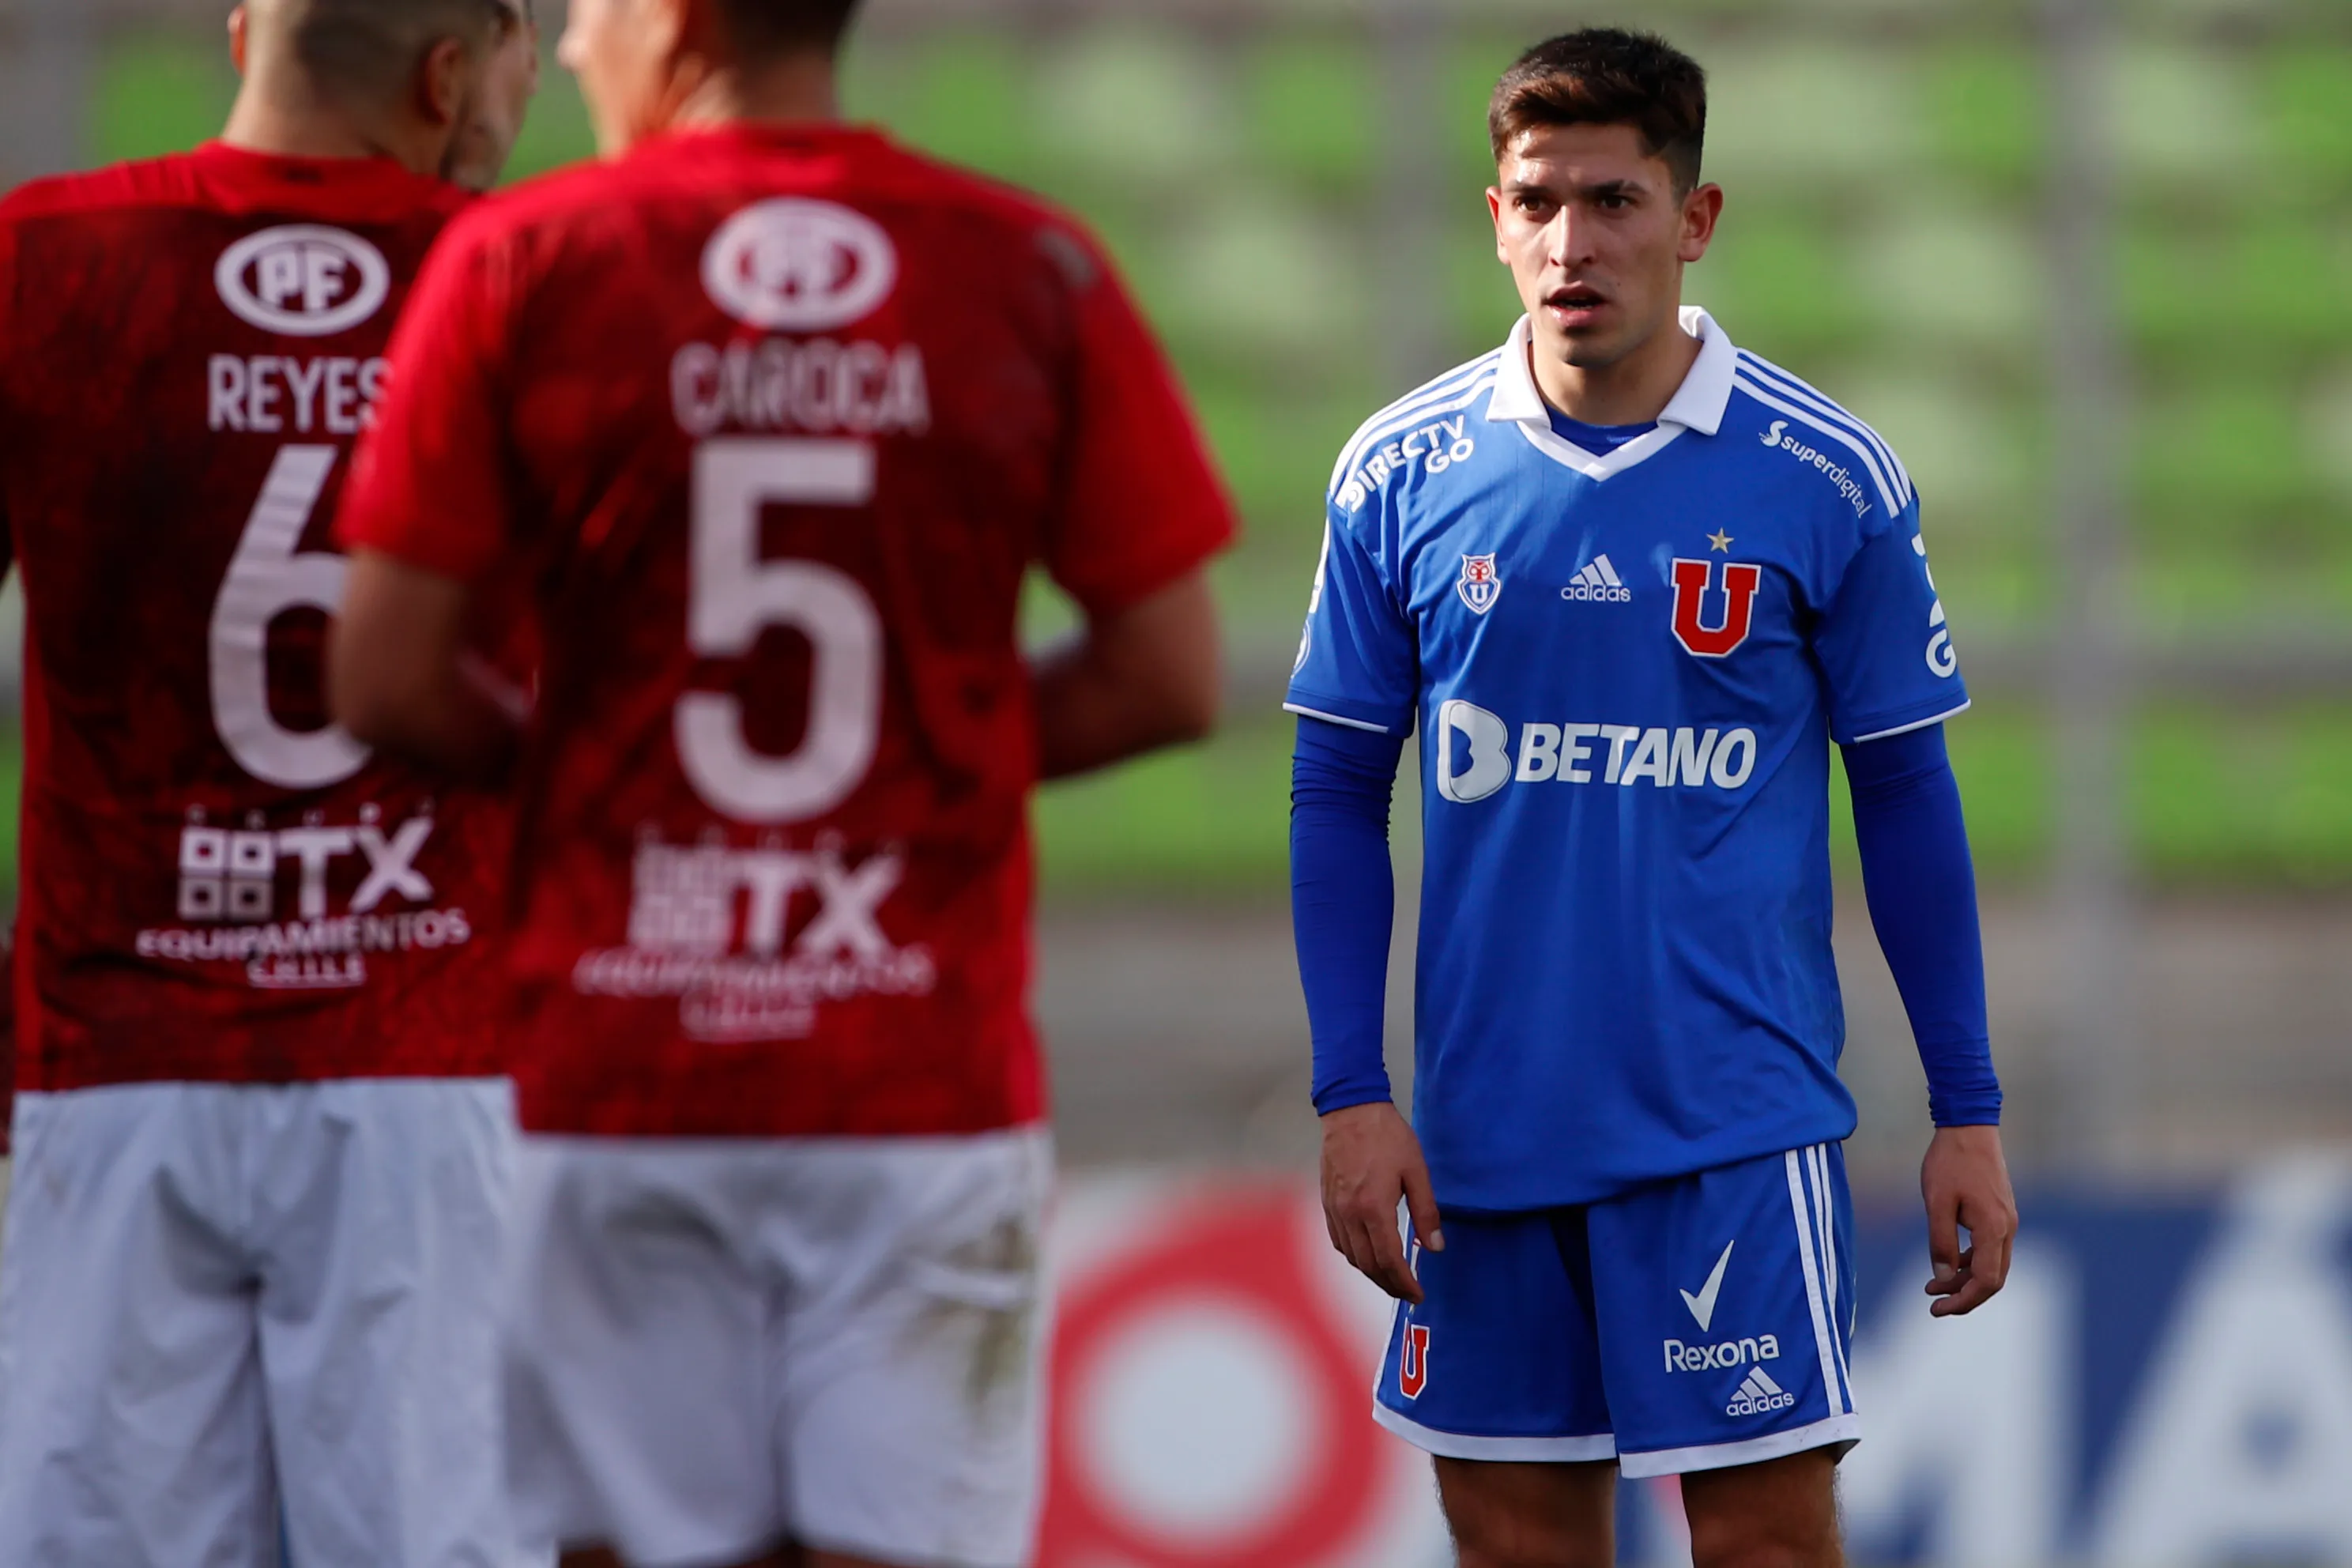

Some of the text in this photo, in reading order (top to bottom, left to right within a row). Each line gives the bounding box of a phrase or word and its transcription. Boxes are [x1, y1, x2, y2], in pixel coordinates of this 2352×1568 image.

[256, 248, 346, 310] PF
[207, 352, 395, 433] REYES
[669, 338, 933, 435] CAROCA
[1334, 414, 1467, 513] DIRECTV
[1425, 438, 1474, 473] GO
[1780, 435, 1872, 518] superdigital
[207, 443, 375, 787] 6
[673, 436, 885, 822] 5
[1561, 581, 1631, 602] adidas
[1671, 557, 1762, 658] U
[1515, 722, 1757, 789] BETANO
[1664, 1334, 1780, 1373] Rexona
[1725, 1393, 1795, 1416] adidas
